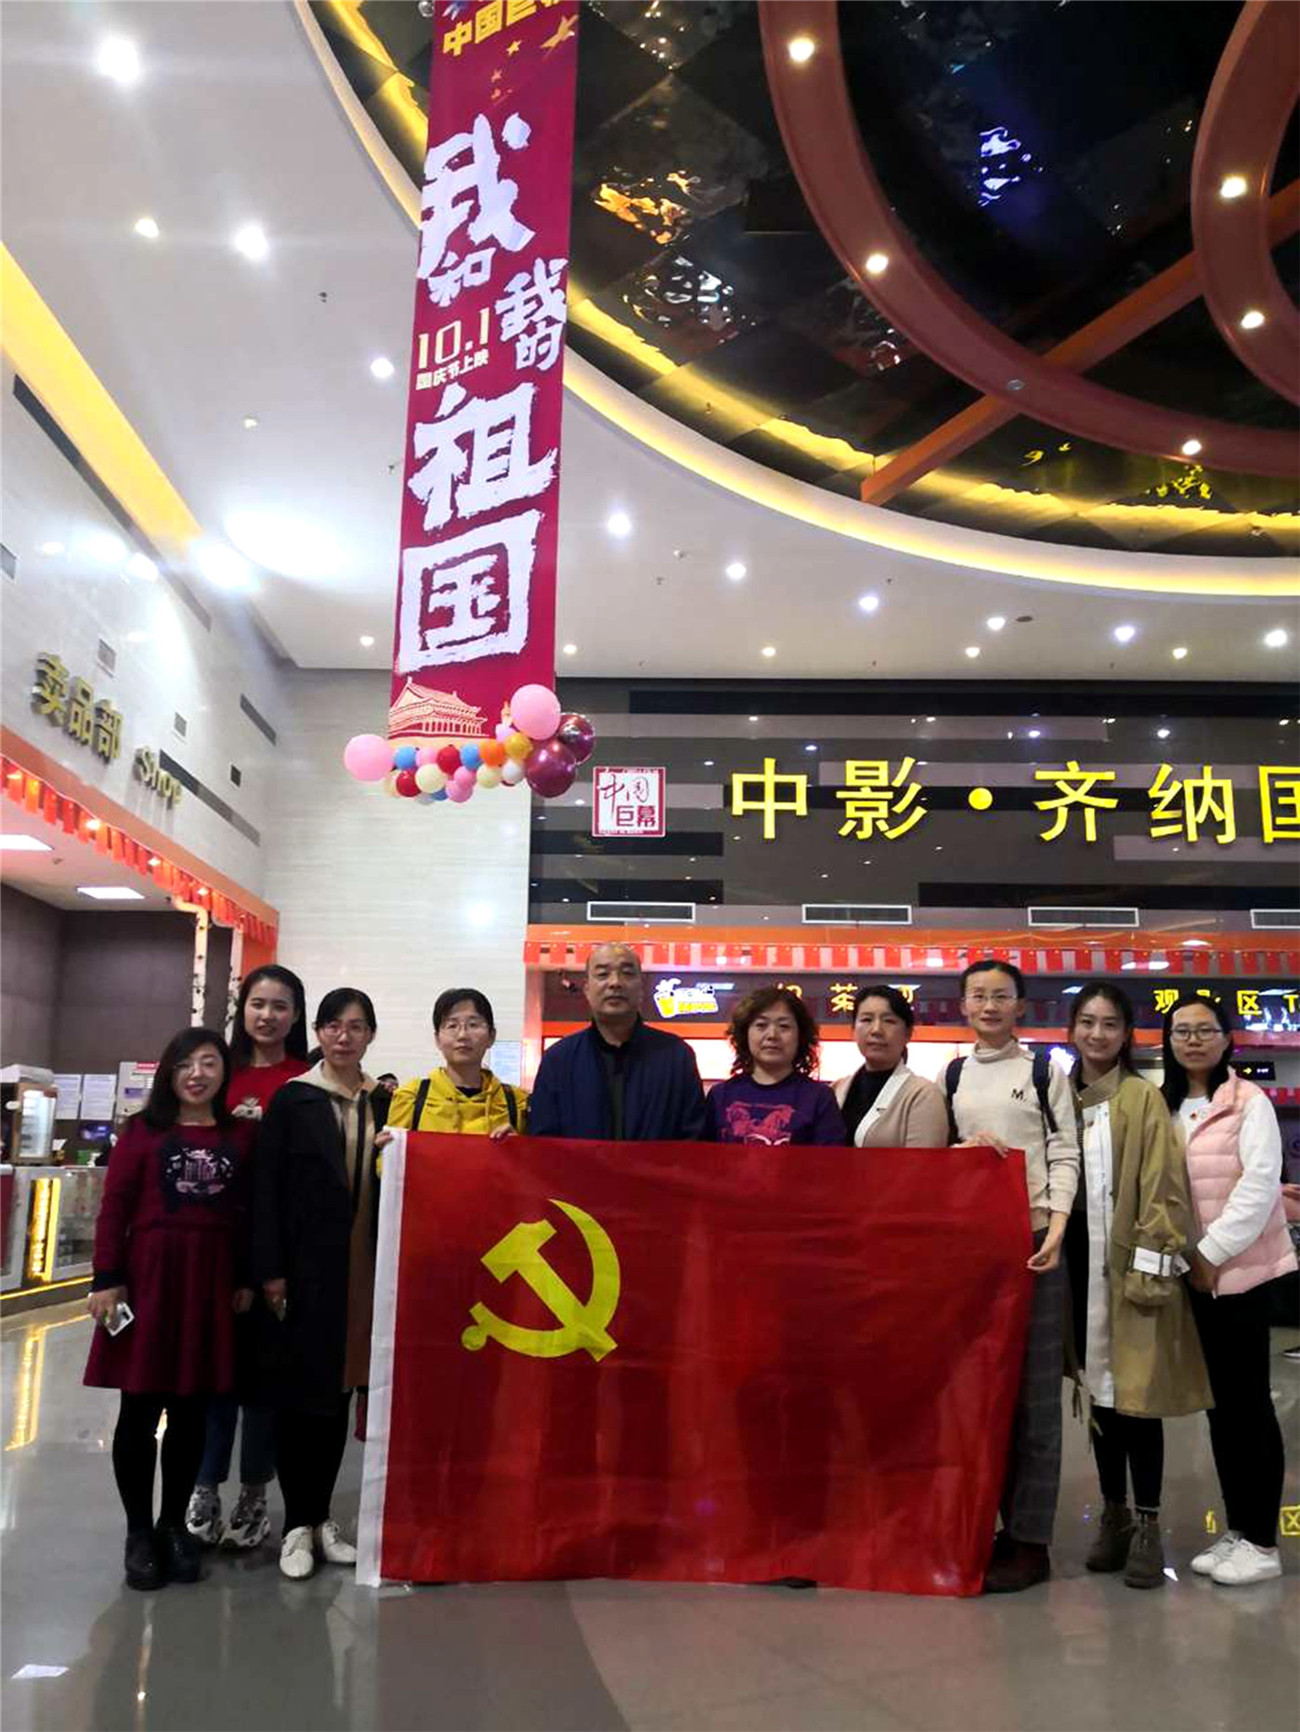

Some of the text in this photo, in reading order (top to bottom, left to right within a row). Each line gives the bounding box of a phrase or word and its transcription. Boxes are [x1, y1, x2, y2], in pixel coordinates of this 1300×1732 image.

[443, 0, 561, 56] 中国巨
[418, 307, 489, 370] 10.1
[415, 349, 489, 391] 国庆节上映
[398, 382, 559, 674] 祖国
[31, 652, 124, 764] 卖品部
[616, 805, 656, 828] 巨幕
